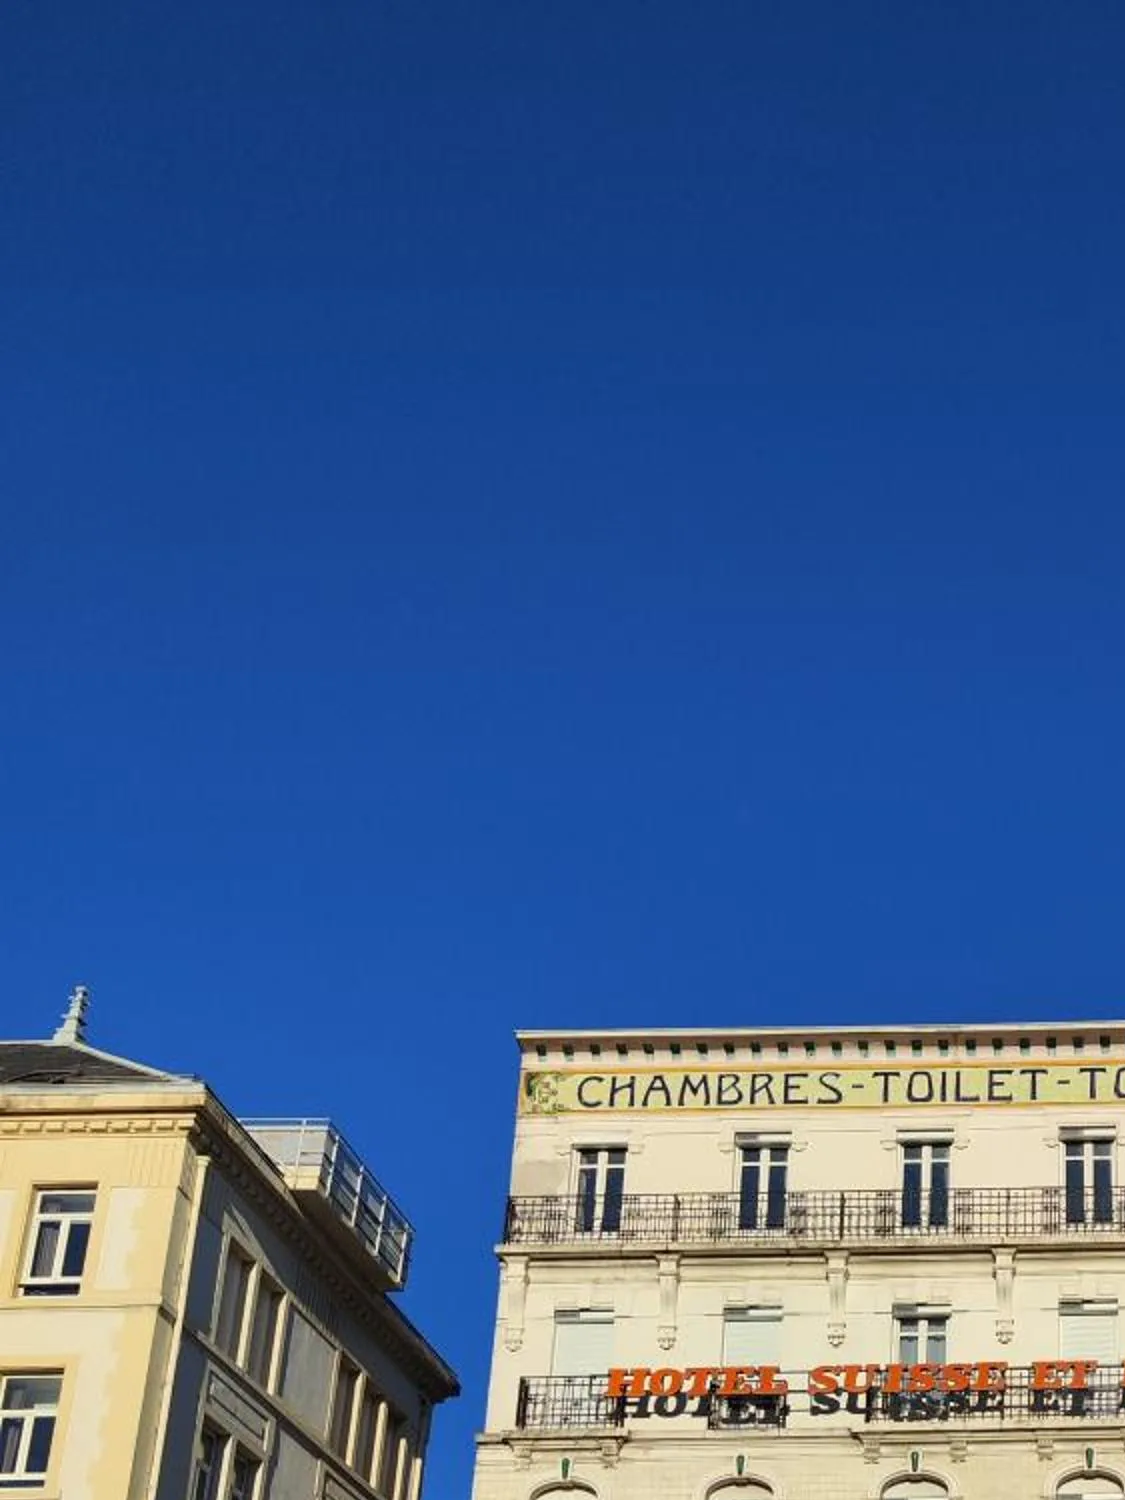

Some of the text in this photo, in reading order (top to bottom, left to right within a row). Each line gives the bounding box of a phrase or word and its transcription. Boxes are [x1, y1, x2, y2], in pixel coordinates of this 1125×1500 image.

[606, 1365, 789, 1397] HOTEL
[808, 1361, 1009, 1395] SUISSE
[1031, 1360, 1098, 1391] ET
